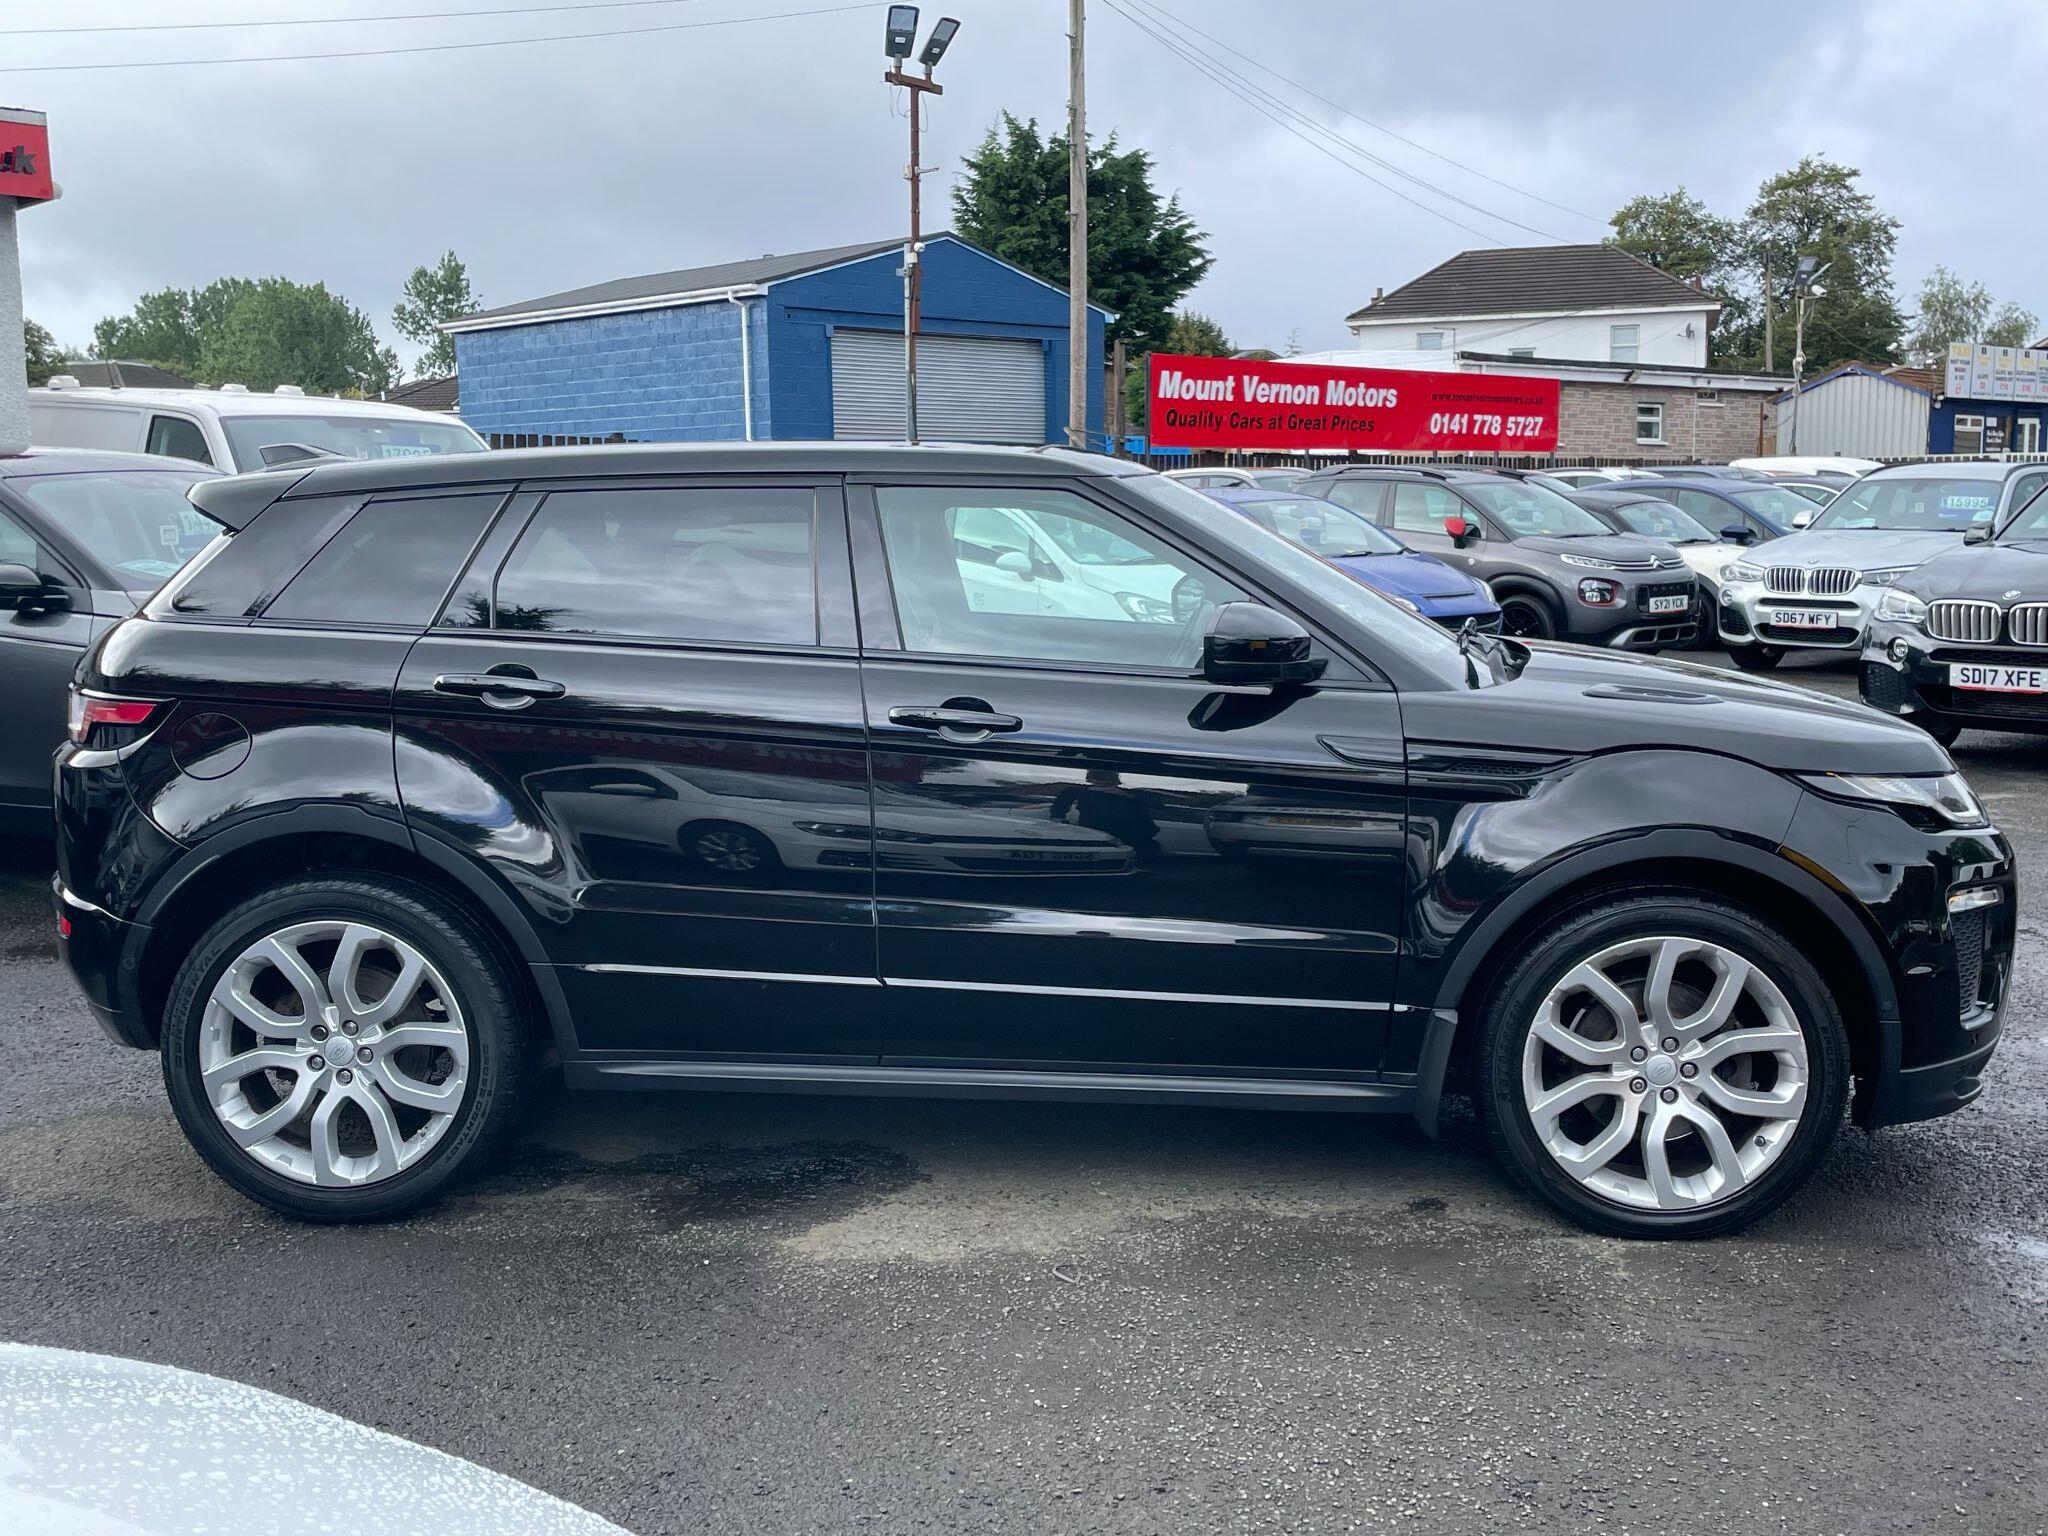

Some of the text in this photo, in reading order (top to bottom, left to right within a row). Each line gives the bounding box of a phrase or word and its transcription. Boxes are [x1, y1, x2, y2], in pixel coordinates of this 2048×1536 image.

[1158, 370, 1398, 408] Mount Vernon Motors
[1166, 408, 1375, 433] Quality Cars at Great Prices
[1429, 412, 1544, 437] 0141 778 5727
[1775, 611, 1832, 625] SD67 WFY
[1960, 667, 2041, 687] SD17 XFE
